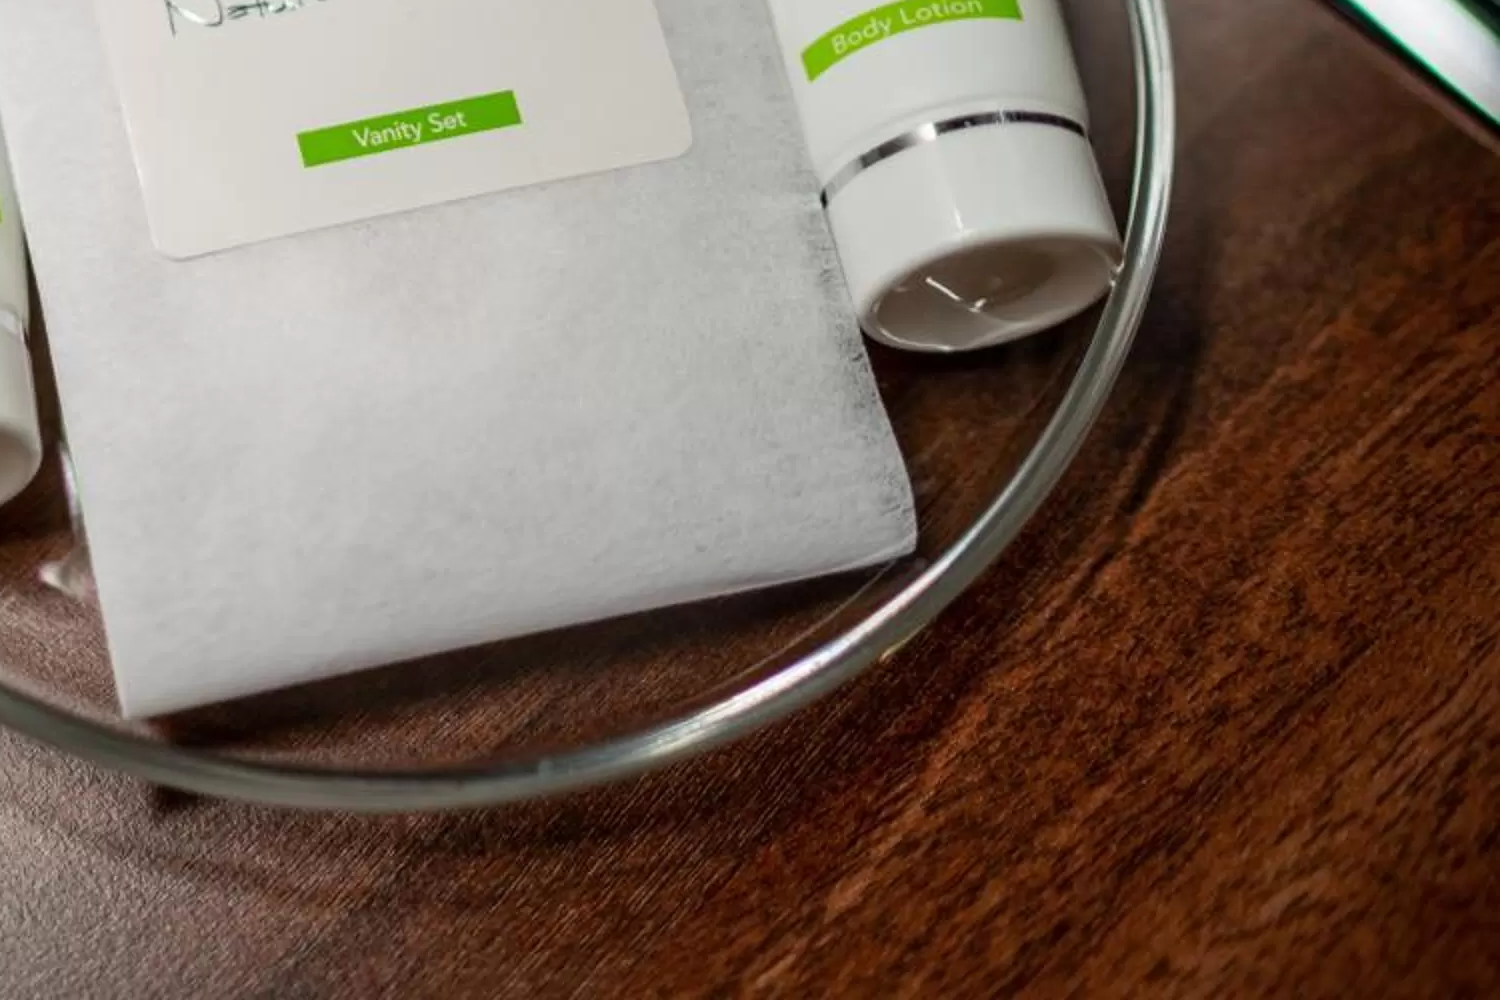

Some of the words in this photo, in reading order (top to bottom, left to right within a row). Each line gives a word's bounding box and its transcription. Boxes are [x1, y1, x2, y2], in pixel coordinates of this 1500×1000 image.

[830, 15, 893, 55] Body
[351, 121, 422, 148] Vanity
[427, 112, 468, 134] Set
